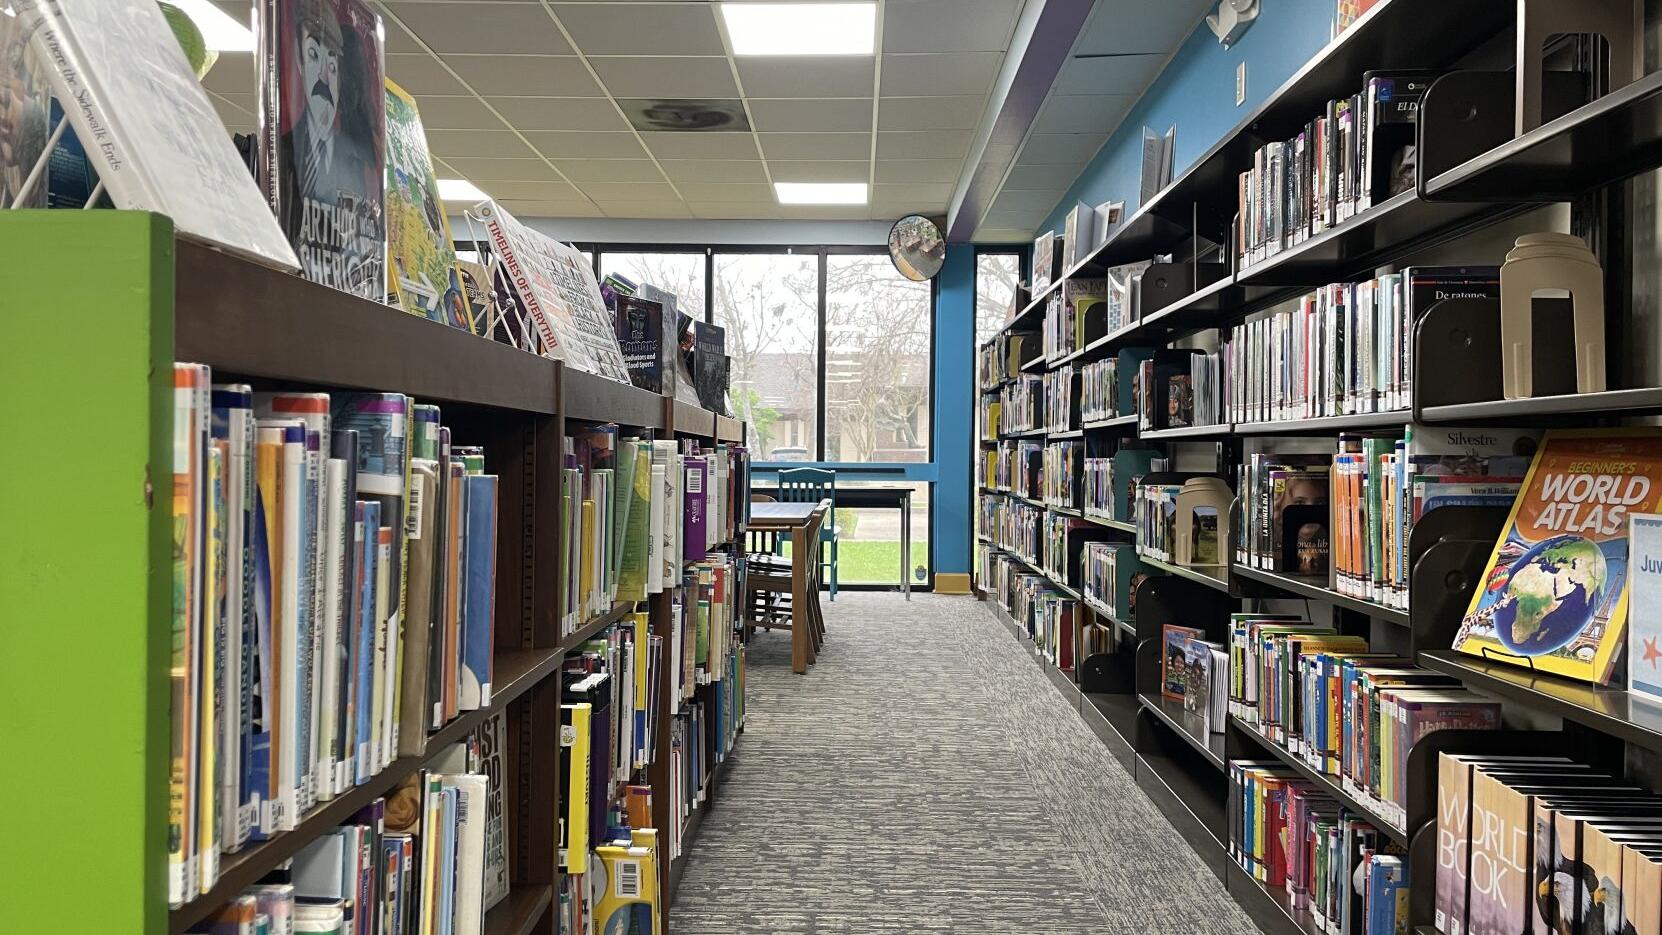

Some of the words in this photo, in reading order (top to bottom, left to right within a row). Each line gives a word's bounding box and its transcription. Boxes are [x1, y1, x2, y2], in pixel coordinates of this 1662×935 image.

[44, 30, 67, 66] Where
[63, 67, 77, 86] the
[73, 88, 105, 140] Sidewalk
[100, 140, 123, 173] Ends
[300, 196, 358, 252] ARTHUR
[488, 219, 522, 278] TIMELINES
[517, 277, 531, 292] OF
[1435, 290, 1450, 300] De
[1447, 431, 1497, 446] Silvestre
[1541, 473, 1651, 506] WORLD
[1568, 462, 1638, 474] BEGINNER'S
[1533, 502, 1627, 536] ATLAS
[1440, 785, 1537, 875] WORLD
[1440, 827, 1508, 909] BOOK
